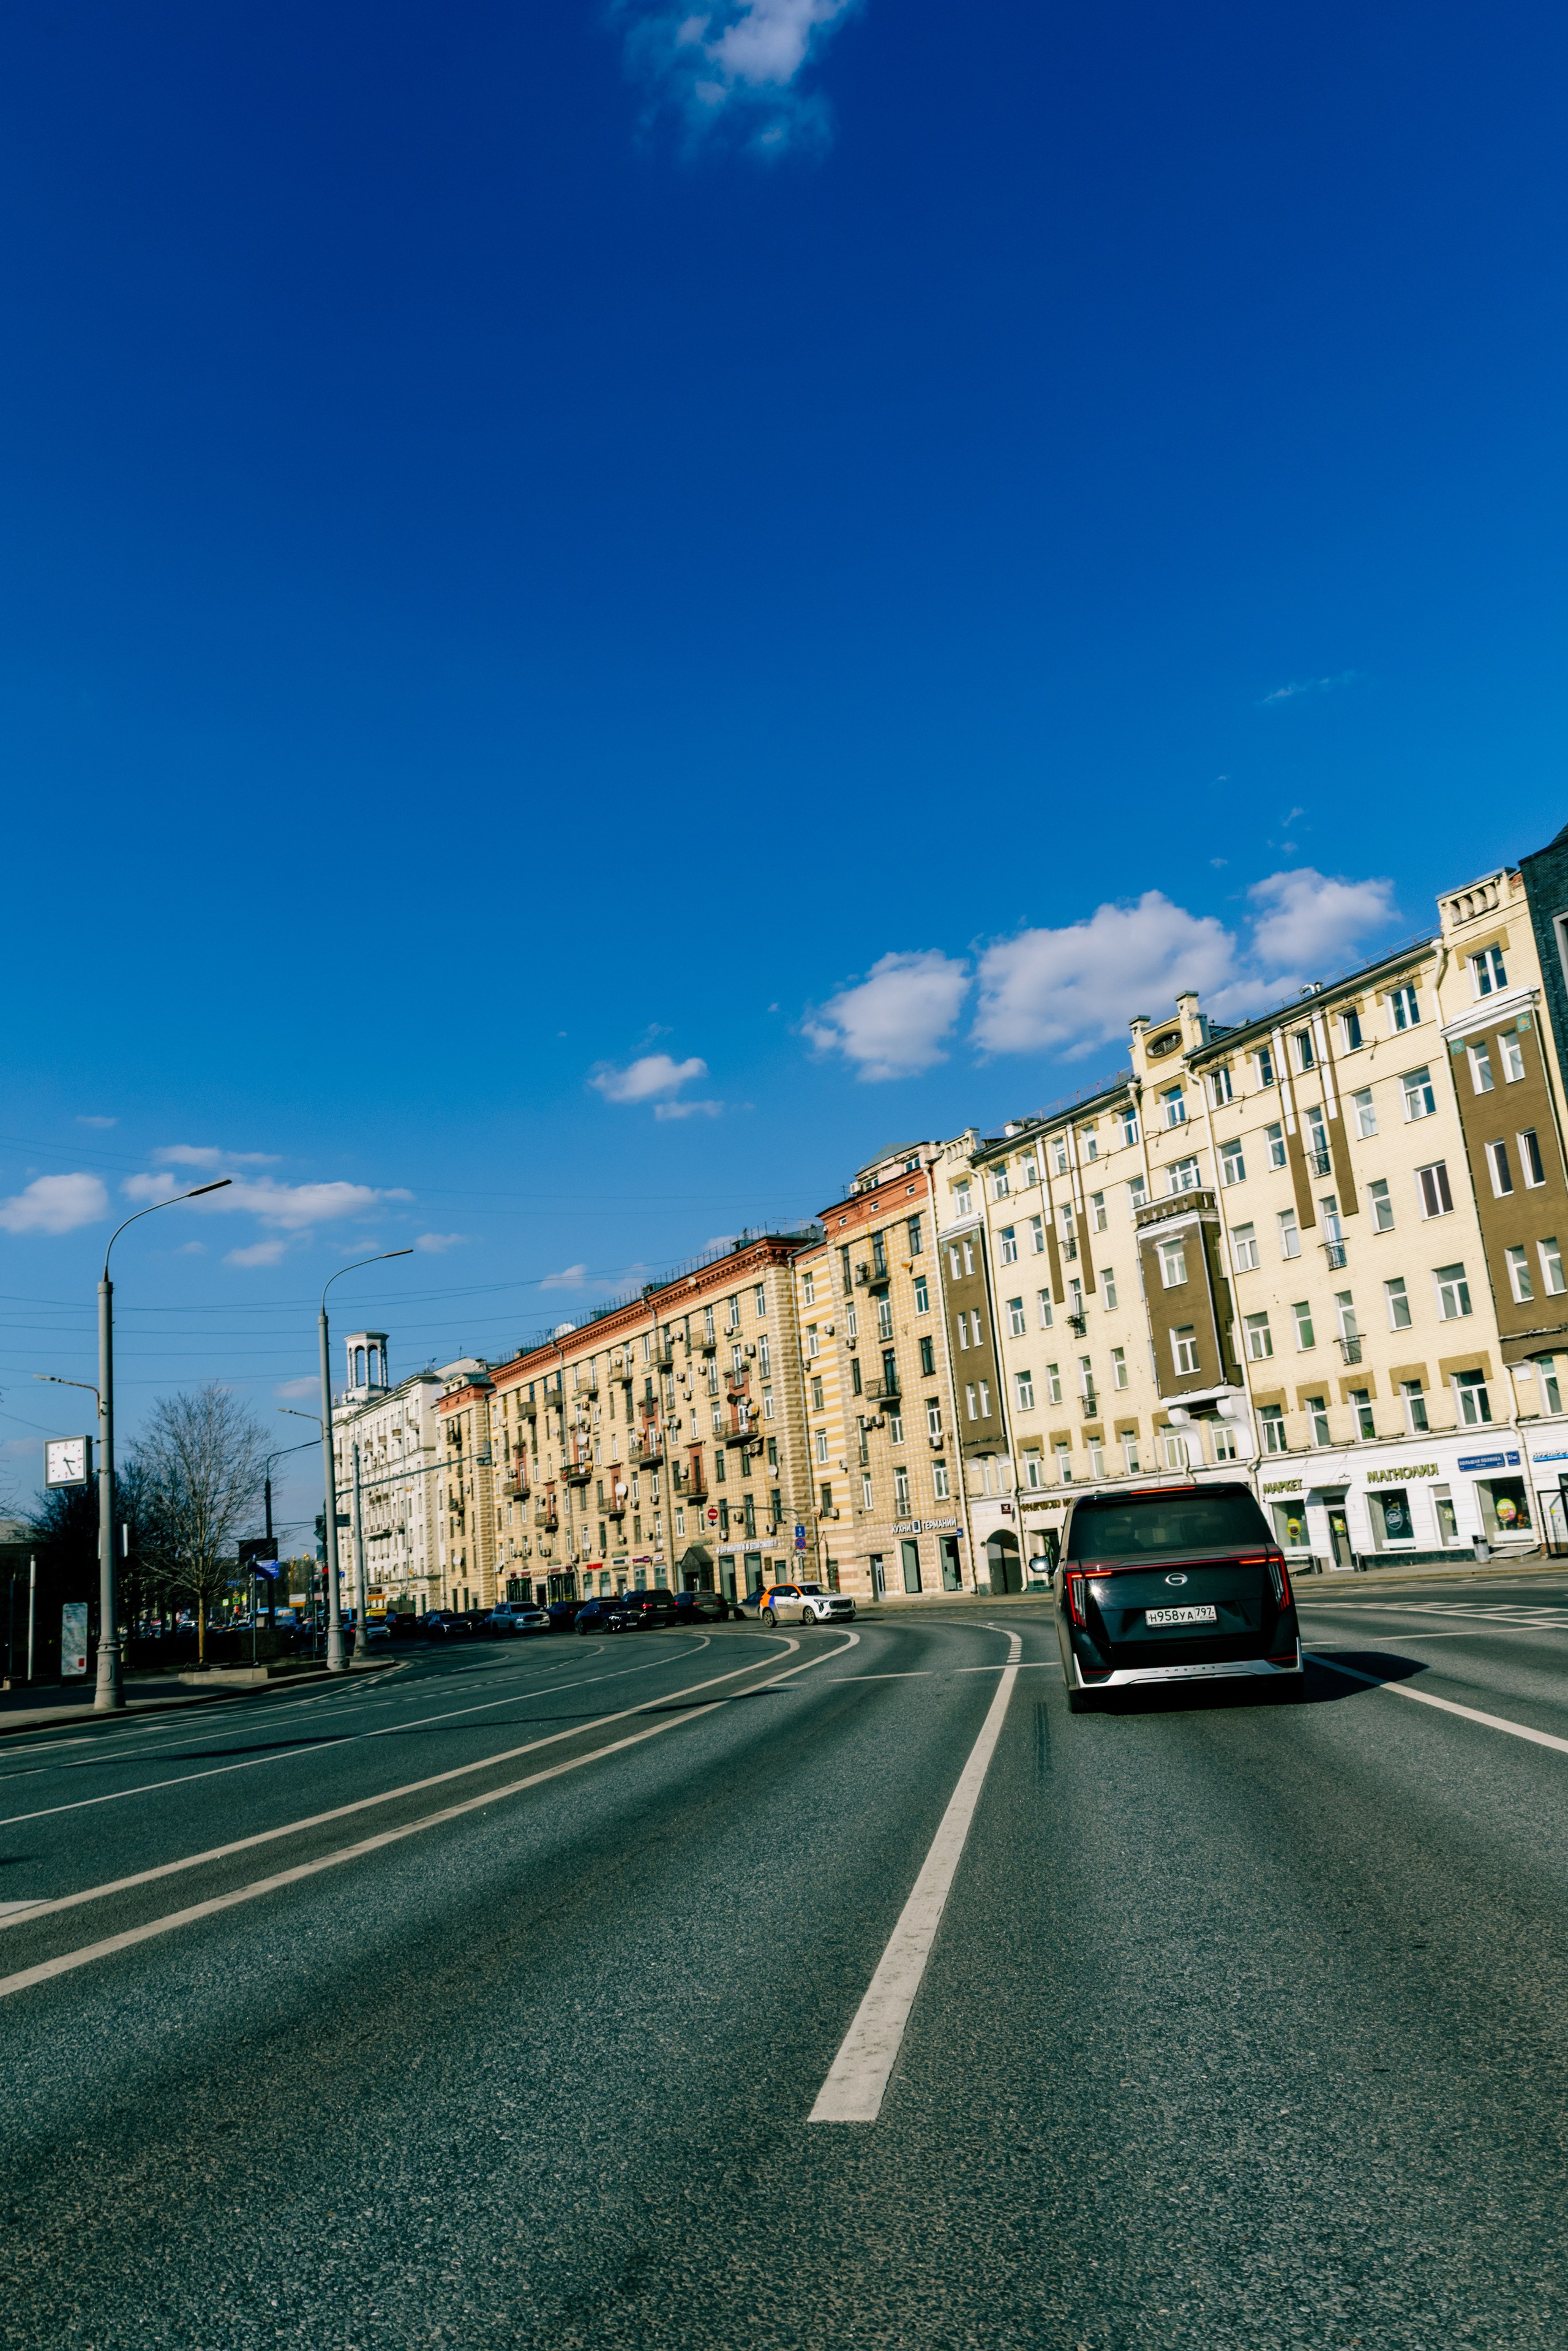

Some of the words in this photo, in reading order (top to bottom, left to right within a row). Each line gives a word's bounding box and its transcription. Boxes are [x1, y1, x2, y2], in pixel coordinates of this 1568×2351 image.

[1367, 1463, 1439, 1483] МАГНОЛИЯ
[1263, 1479, 1302, 1494] МАРКЕТ
[891, 1523, 912, 1534] КУХНИ
[923, 1517, 957, 1530] ГЕРМАНИИ
[1195, 1608, 1212, 1616] 797
